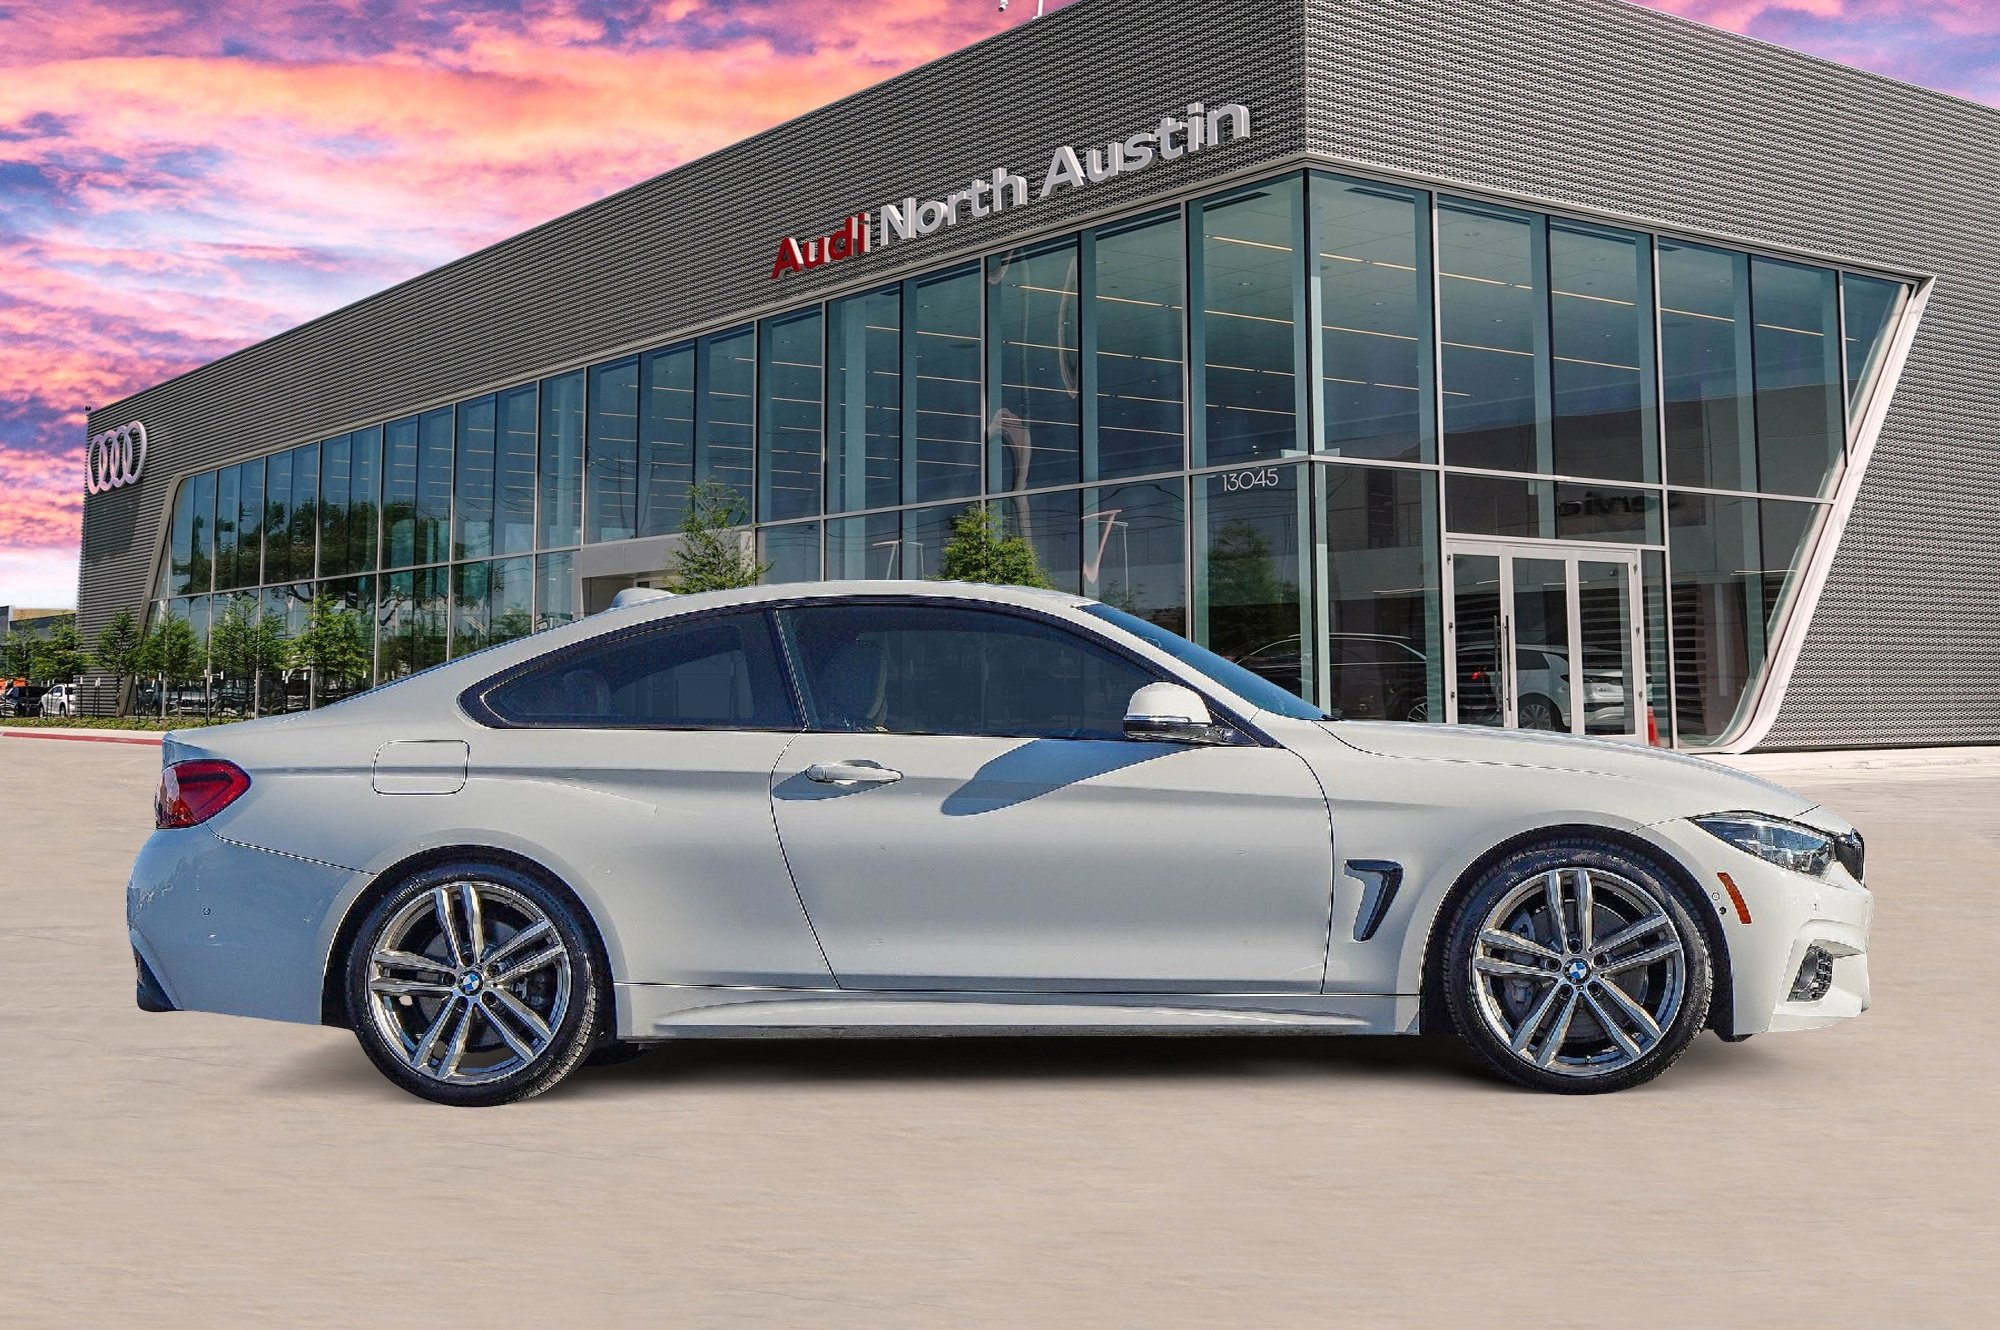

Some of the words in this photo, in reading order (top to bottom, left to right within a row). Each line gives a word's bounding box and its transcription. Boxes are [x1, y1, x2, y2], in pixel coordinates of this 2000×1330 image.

[770, 212, 871, 280] Audi
[880, 167, 1028, 247] North
[1039, 102, 1250, 198] Austin
[1222, 467, 1279, 492] 13045
